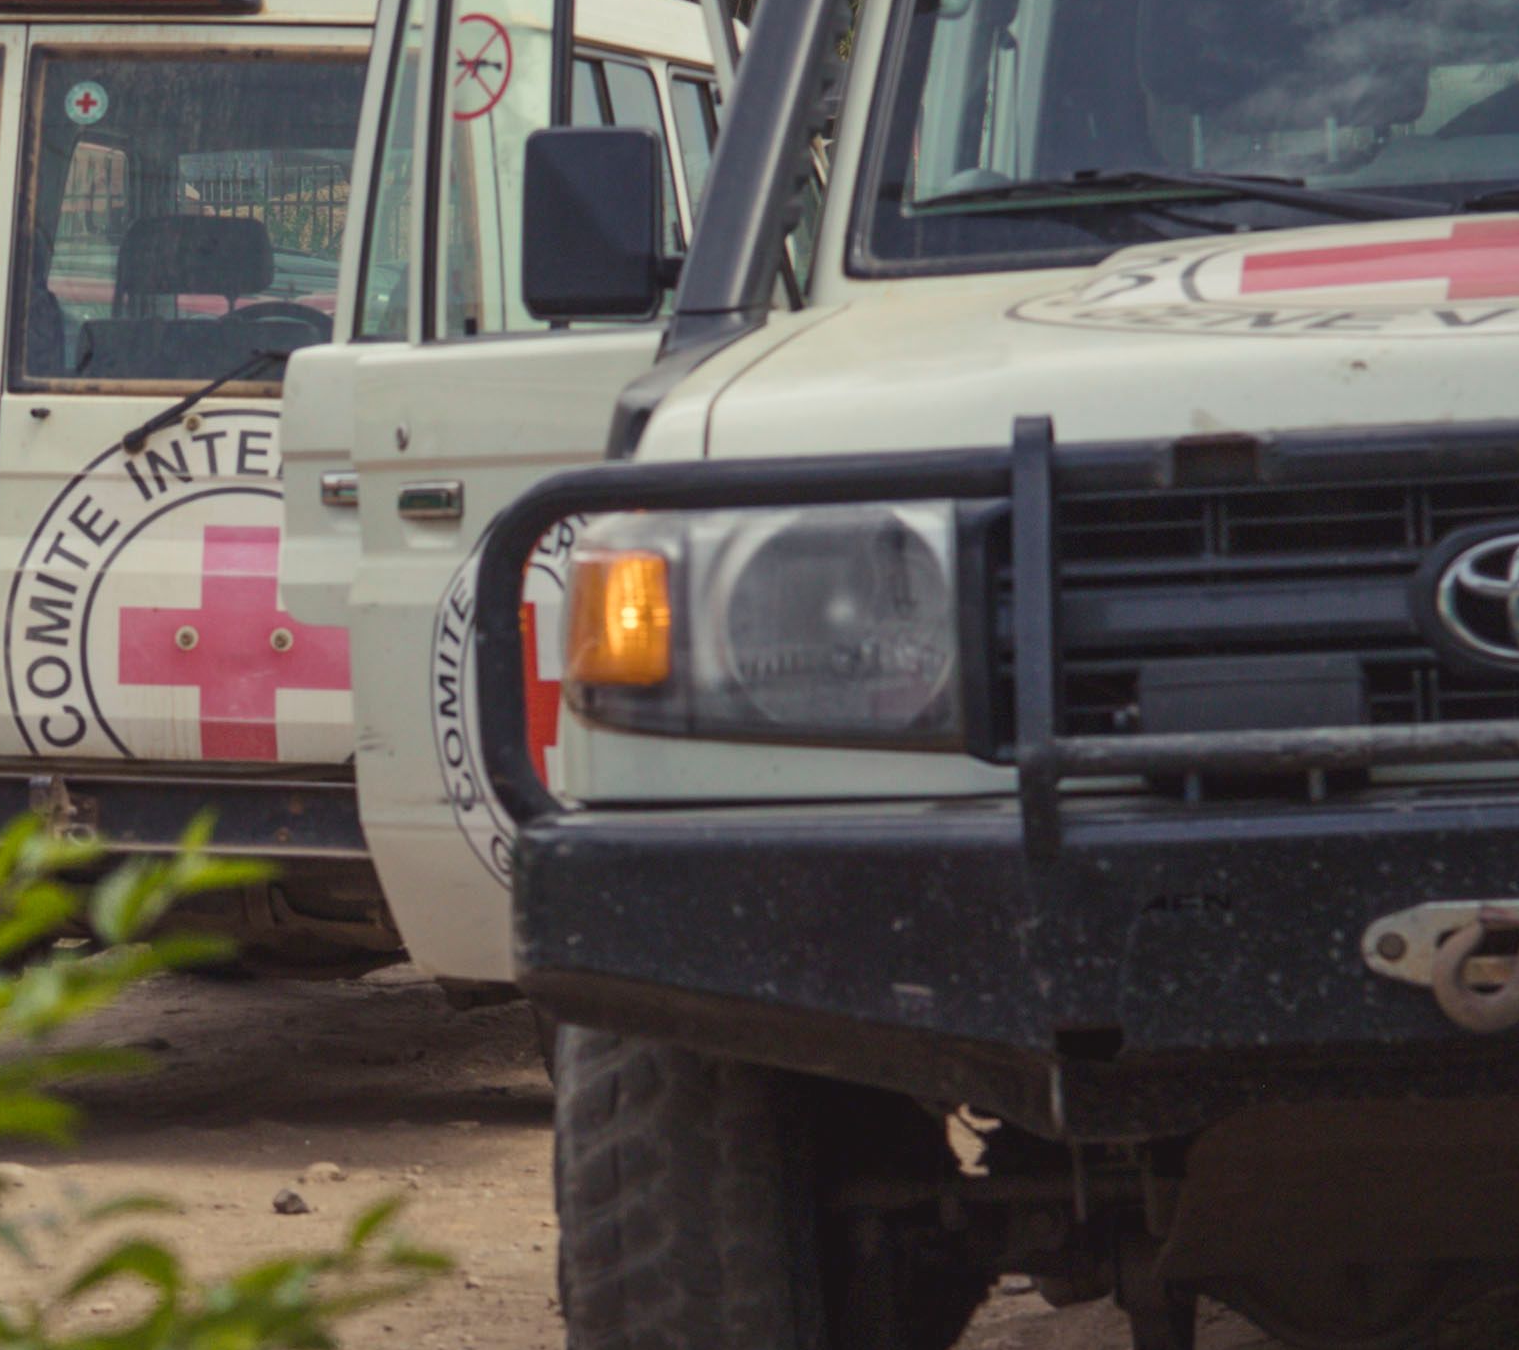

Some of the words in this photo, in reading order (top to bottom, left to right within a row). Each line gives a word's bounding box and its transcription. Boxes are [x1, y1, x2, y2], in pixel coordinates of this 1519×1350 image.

[24, 494, 121, 748] COMITE
[124, 430, 283, 502] INTE
[437, 574, 477, 813] COMITE
